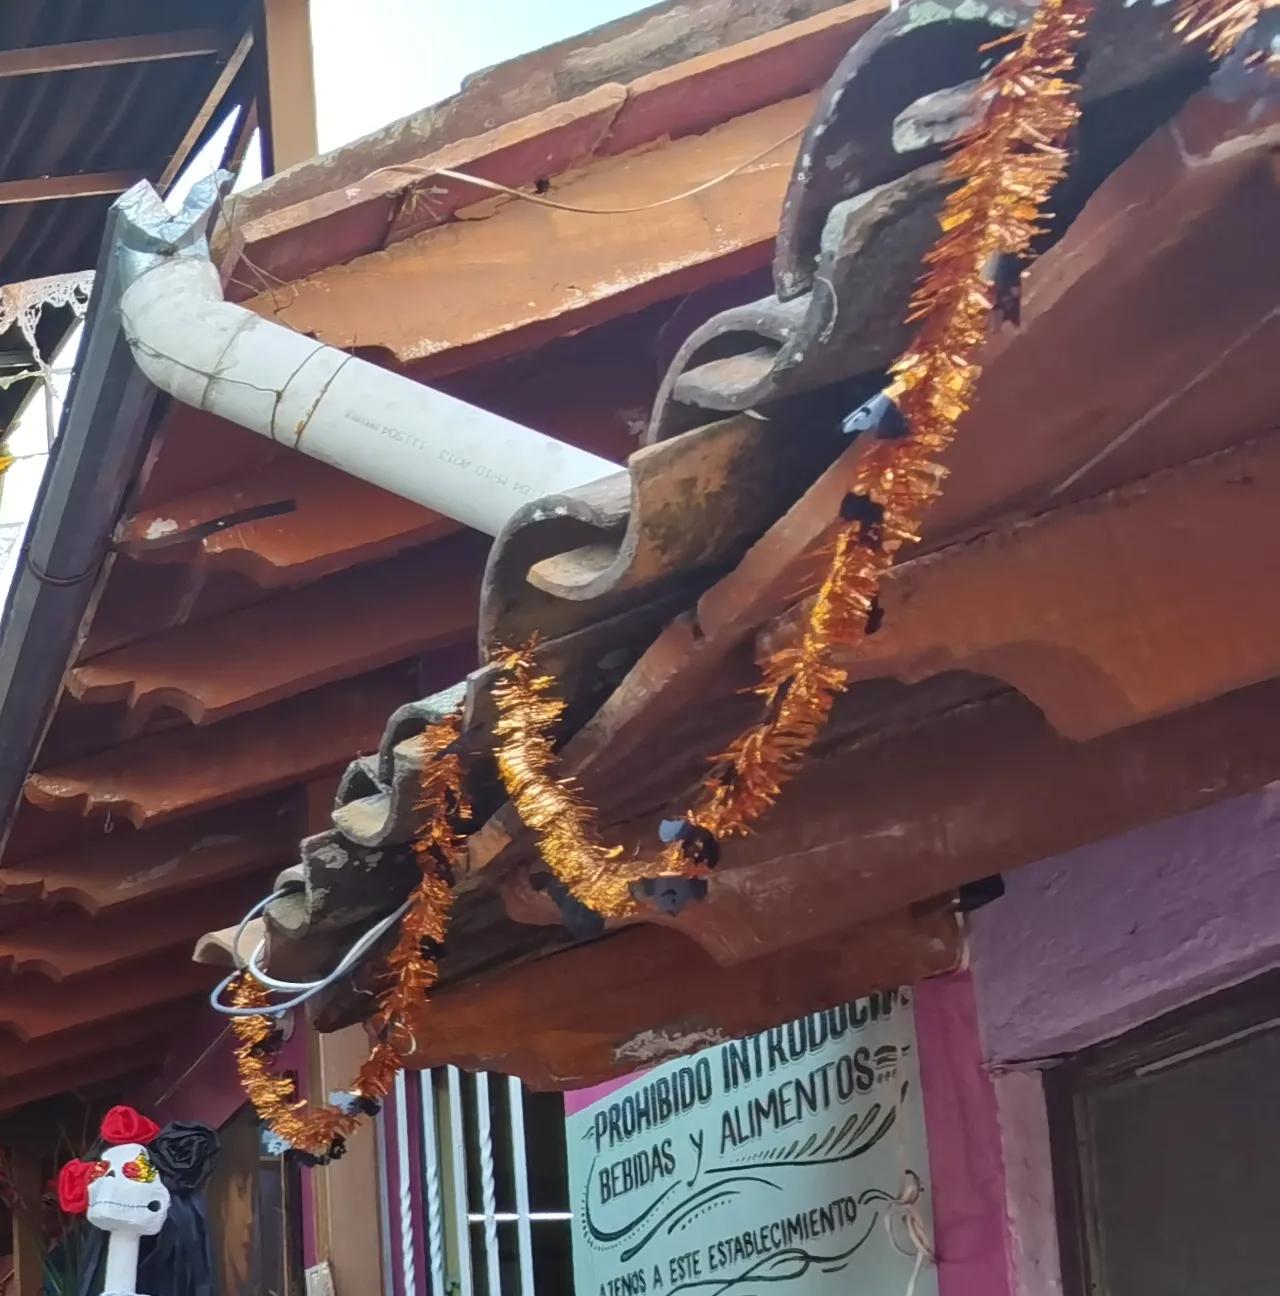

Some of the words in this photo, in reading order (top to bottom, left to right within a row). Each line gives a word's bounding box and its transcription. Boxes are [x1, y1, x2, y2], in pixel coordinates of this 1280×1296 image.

[594, 1056, 712, 1154] PROHIBIDO
[598, 1138, 676, 1204] BEBIDAS
[720, 1046, 875, 1155] ALIMENTOS
[653, 1264, 664, 1291] A
[669, 1250, 702, 1285] ESTE
[708, 1195, 858, 1272] ESTABLECIMIENTO
